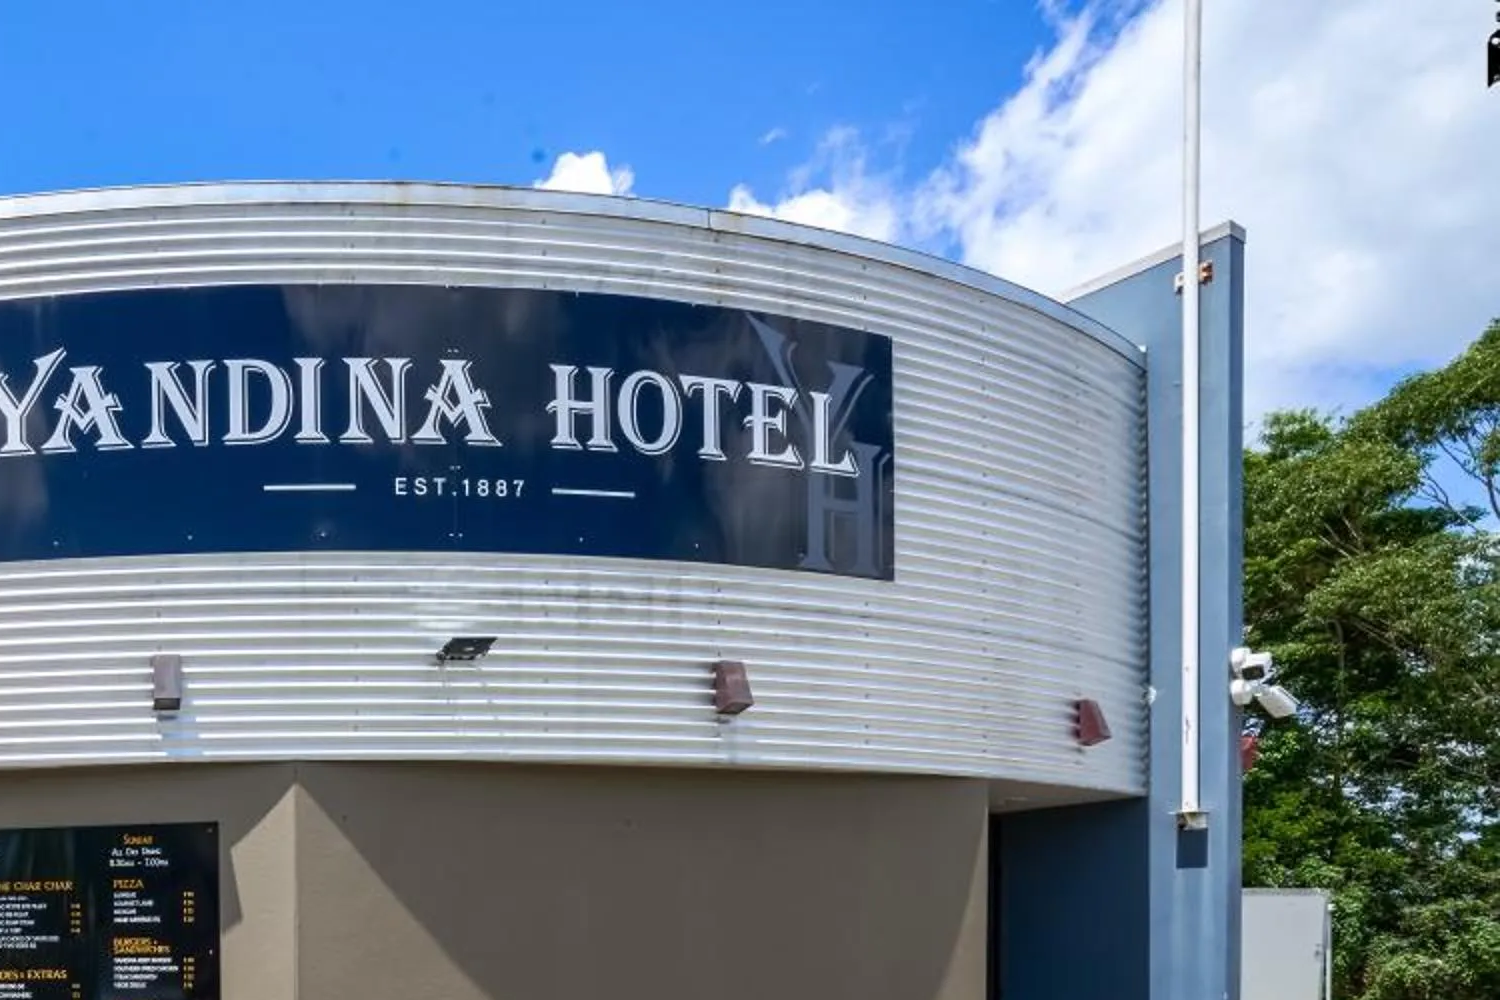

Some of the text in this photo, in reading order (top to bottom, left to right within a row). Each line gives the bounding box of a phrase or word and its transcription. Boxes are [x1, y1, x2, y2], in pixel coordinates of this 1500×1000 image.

[545, 363, 861, 478] HOTEL
[395, 476, 525, 497] EST.1887
[113, 879, 144, 889] PIZZA
[27, 969, 68, 979] EXTRAS
